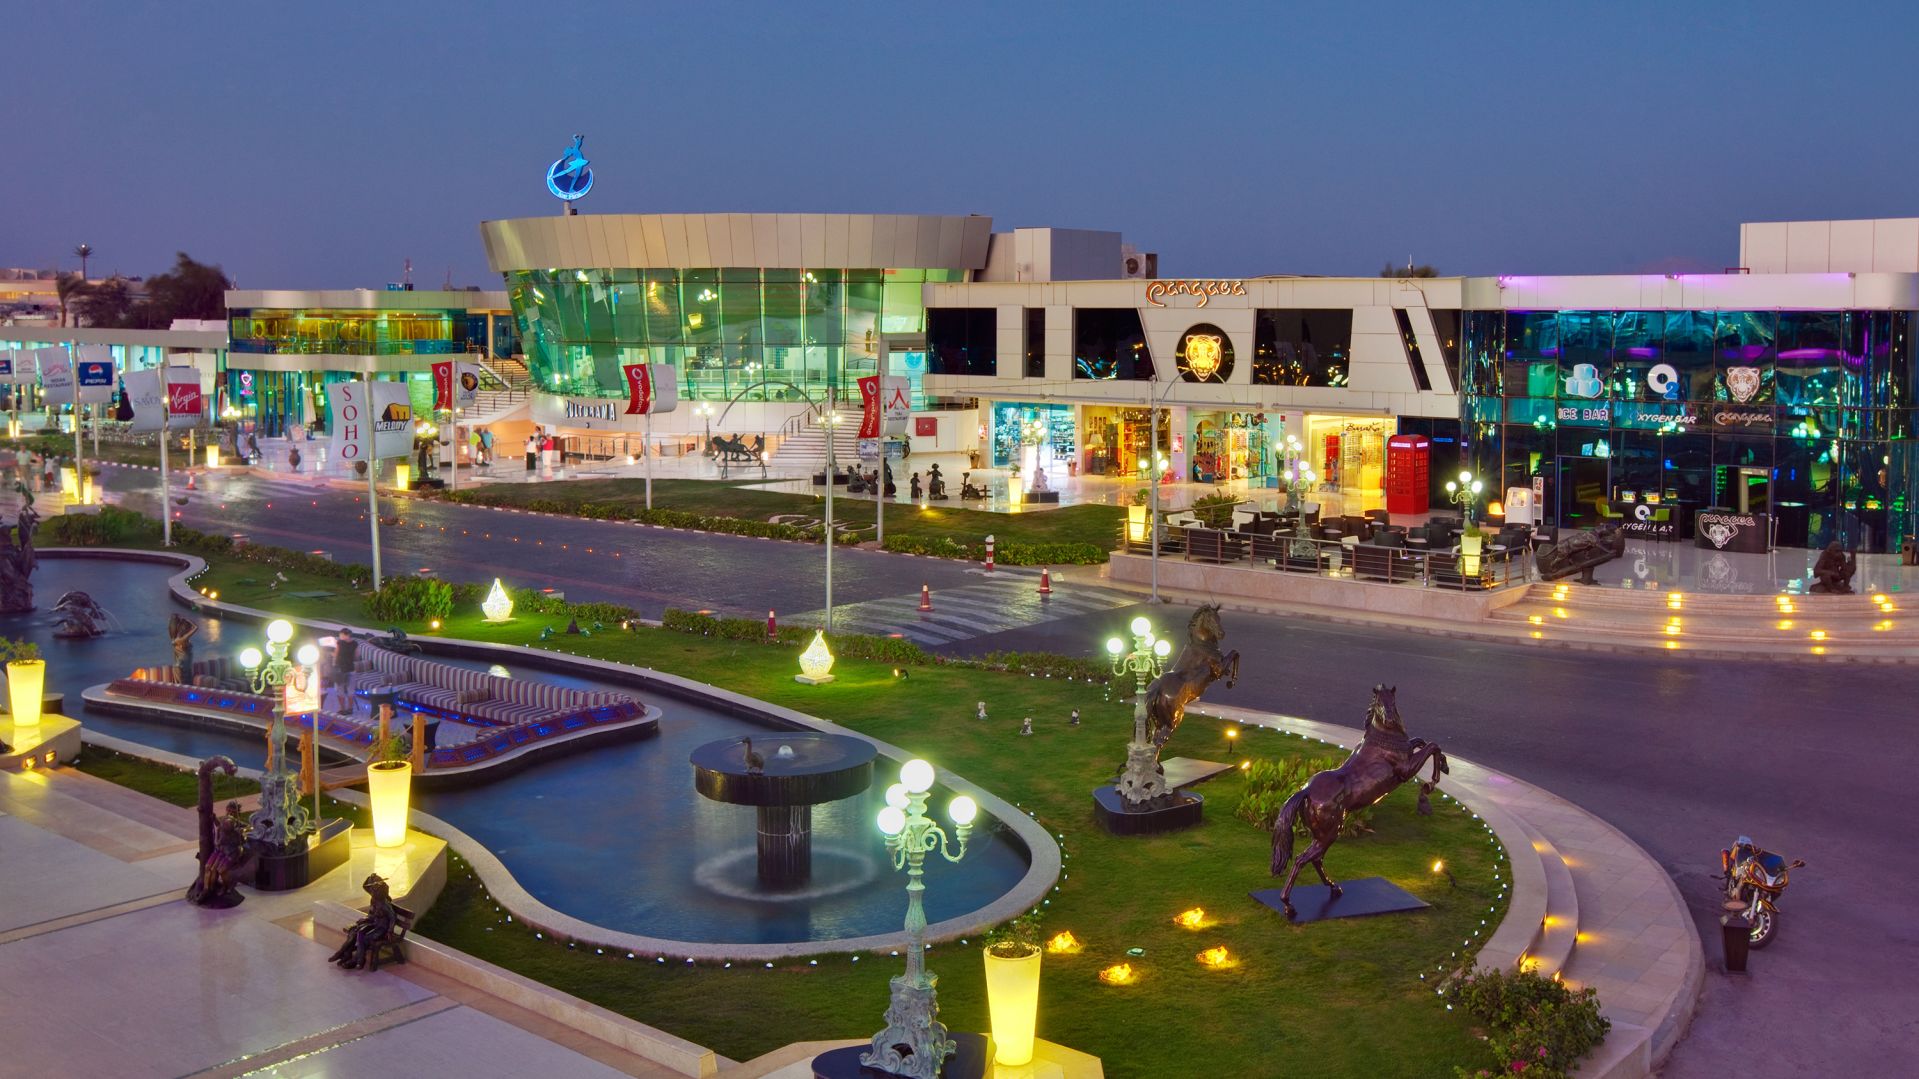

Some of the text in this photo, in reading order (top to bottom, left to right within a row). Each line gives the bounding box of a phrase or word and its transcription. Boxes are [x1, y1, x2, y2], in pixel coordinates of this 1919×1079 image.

[170, 386, 199, 411] Virgin
[341, 385, 359, 460] SOHO
[1583, 408, 1608, 421] BAR
[1674, 414, 1698, 425] BAR
